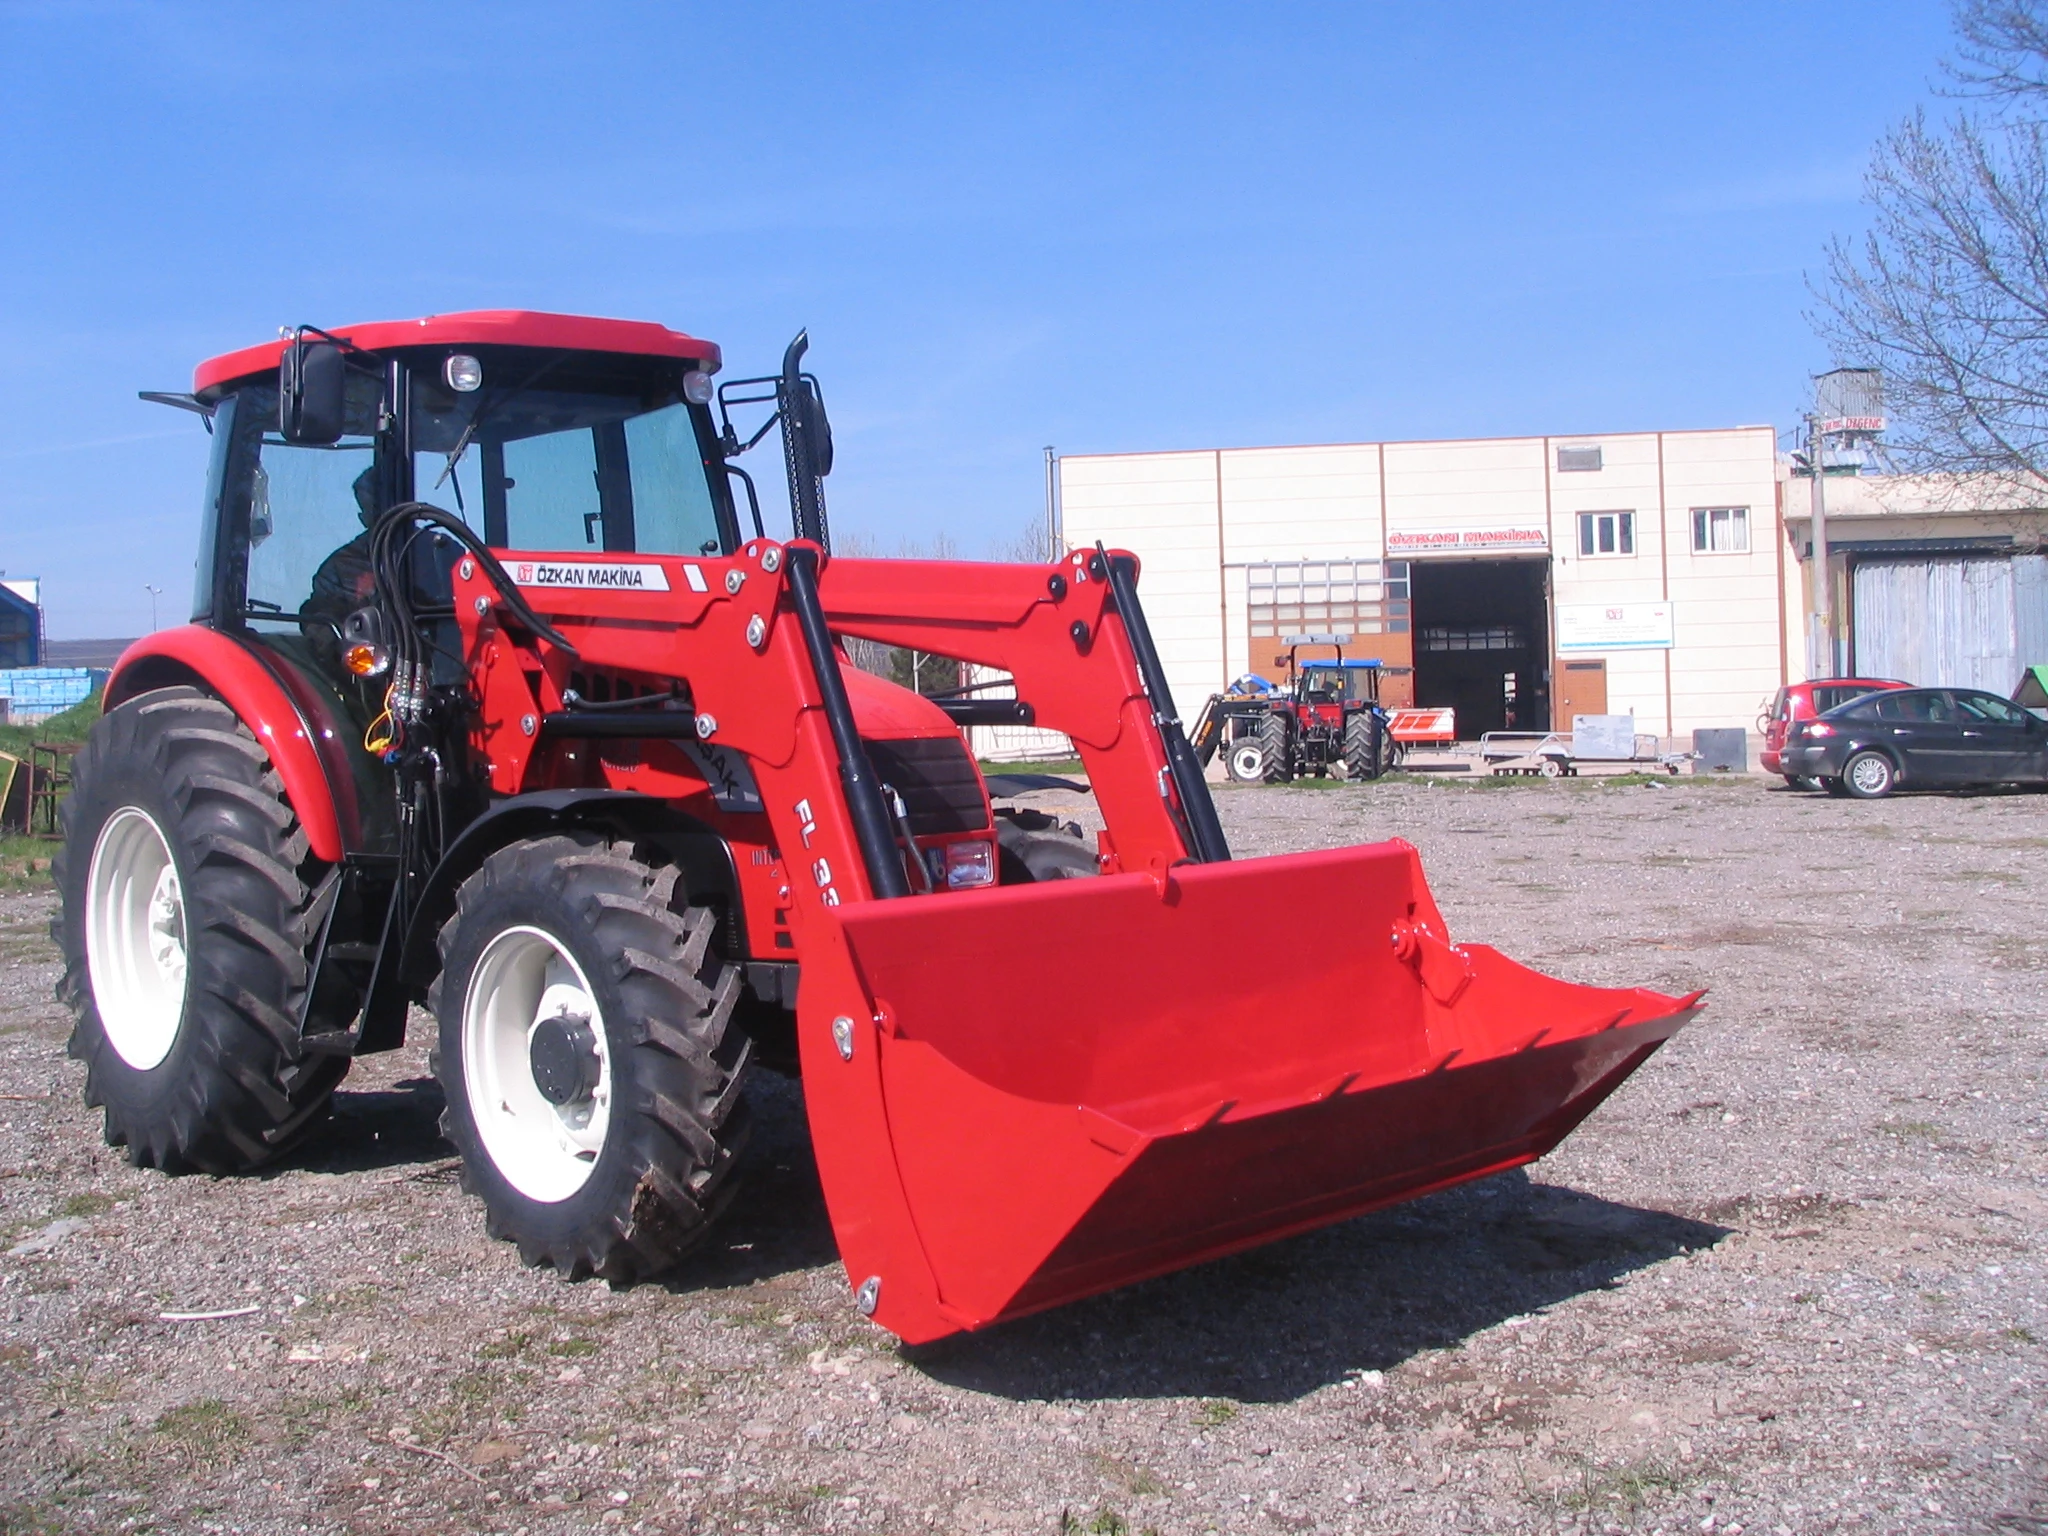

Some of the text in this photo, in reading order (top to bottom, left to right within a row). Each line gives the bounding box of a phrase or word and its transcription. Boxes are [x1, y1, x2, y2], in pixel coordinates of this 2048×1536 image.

[537, 564, 584, 585] ÖZKAN
[587, 566, 643, 587] MAKİNA
[793, 798, 816, 849] FL
